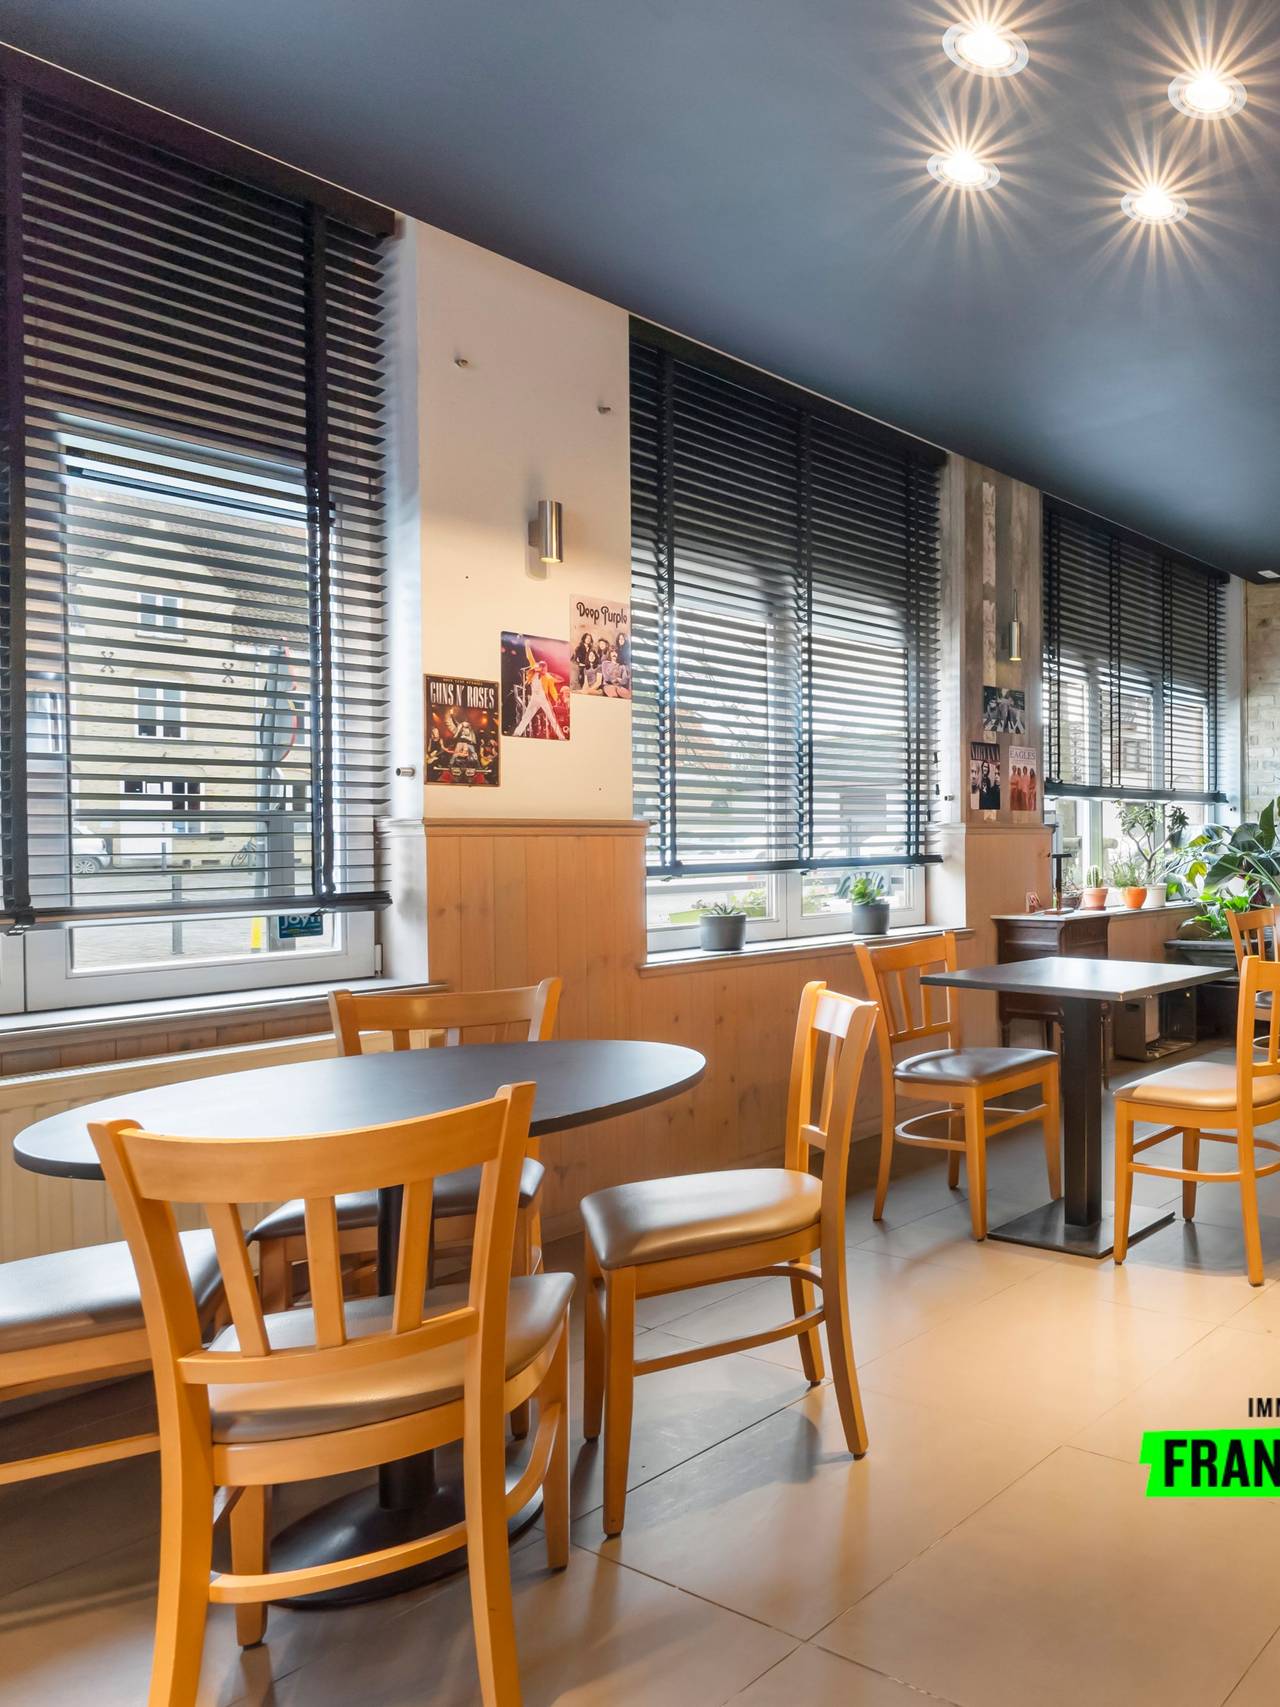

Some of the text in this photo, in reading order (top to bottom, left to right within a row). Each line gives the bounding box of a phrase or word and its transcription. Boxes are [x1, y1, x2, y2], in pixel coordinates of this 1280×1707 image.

[576, 602, 627, 628] Deep Purple
[430, 682, 454, 705] GUNS
[467, 686, 495, 709] ROSES
[1010, 750, 1036, 760] EAGLES
